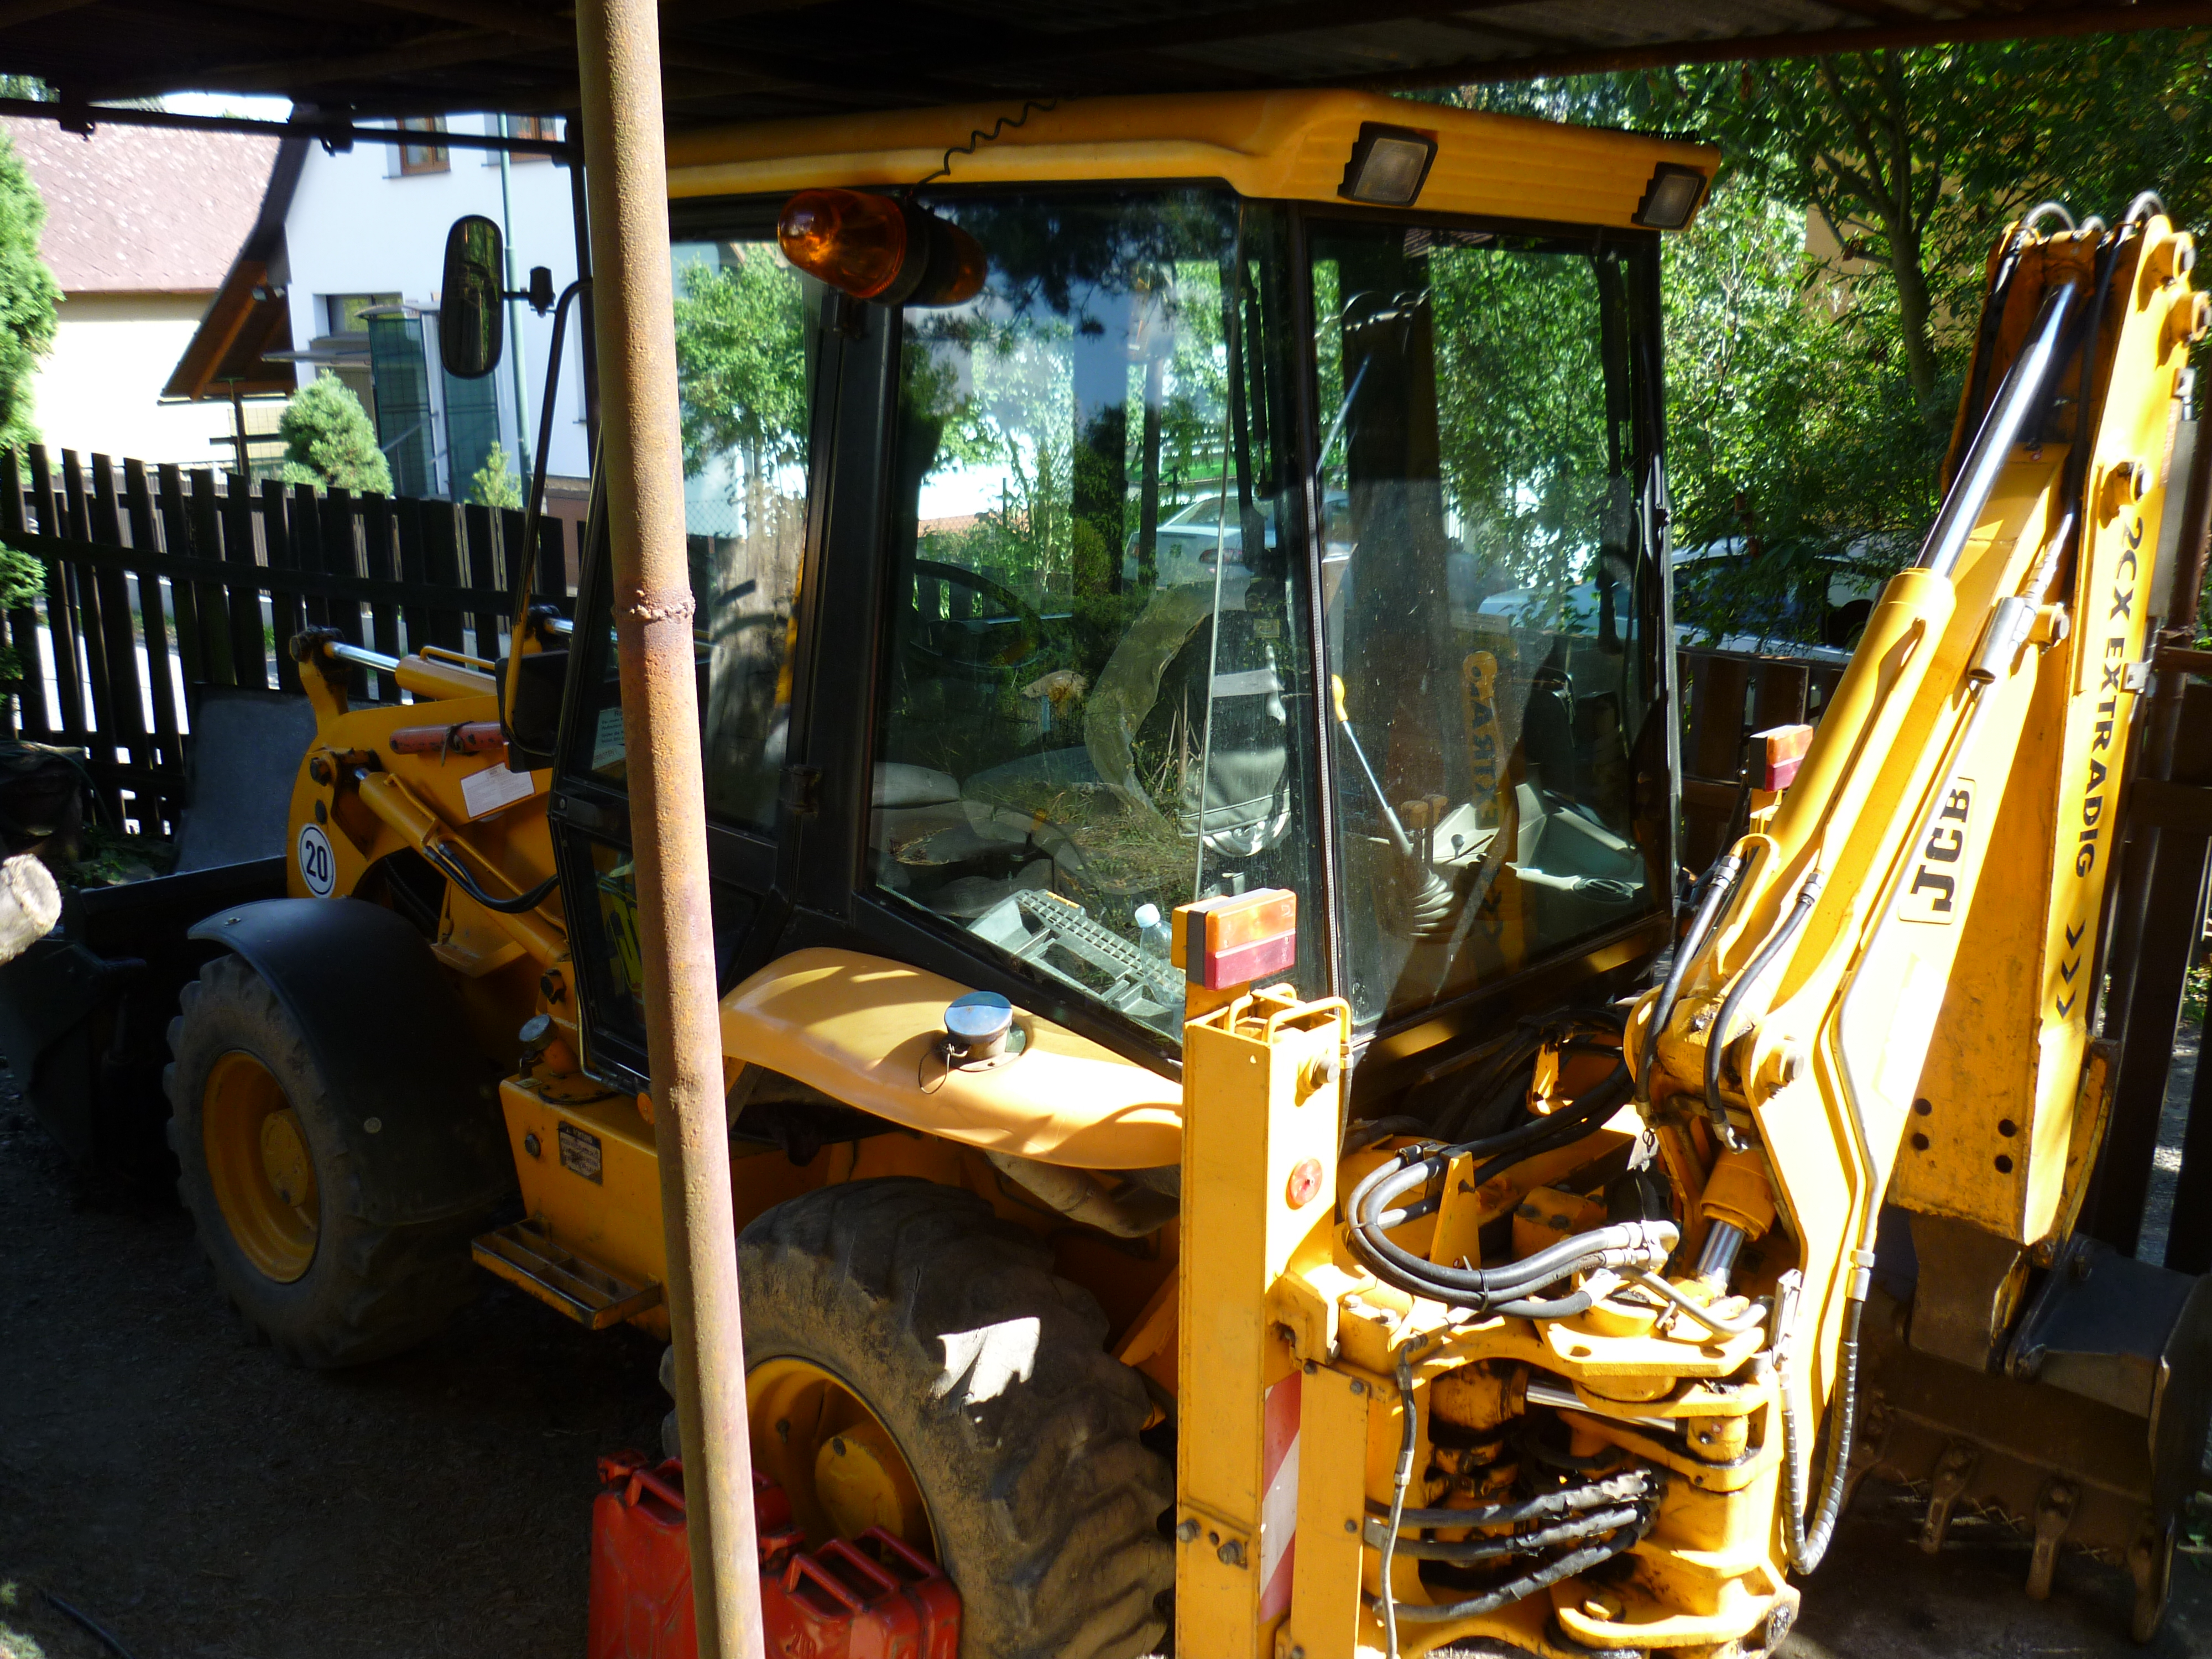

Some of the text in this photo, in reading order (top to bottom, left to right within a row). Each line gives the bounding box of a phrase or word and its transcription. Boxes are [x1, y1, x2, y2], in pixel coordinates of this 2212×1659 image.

[2075, 517, 2143, 878] 2CX EXTRADIG
[306, 840, 327, 882] 20
[1910, 789, 1970, 912] JCB
